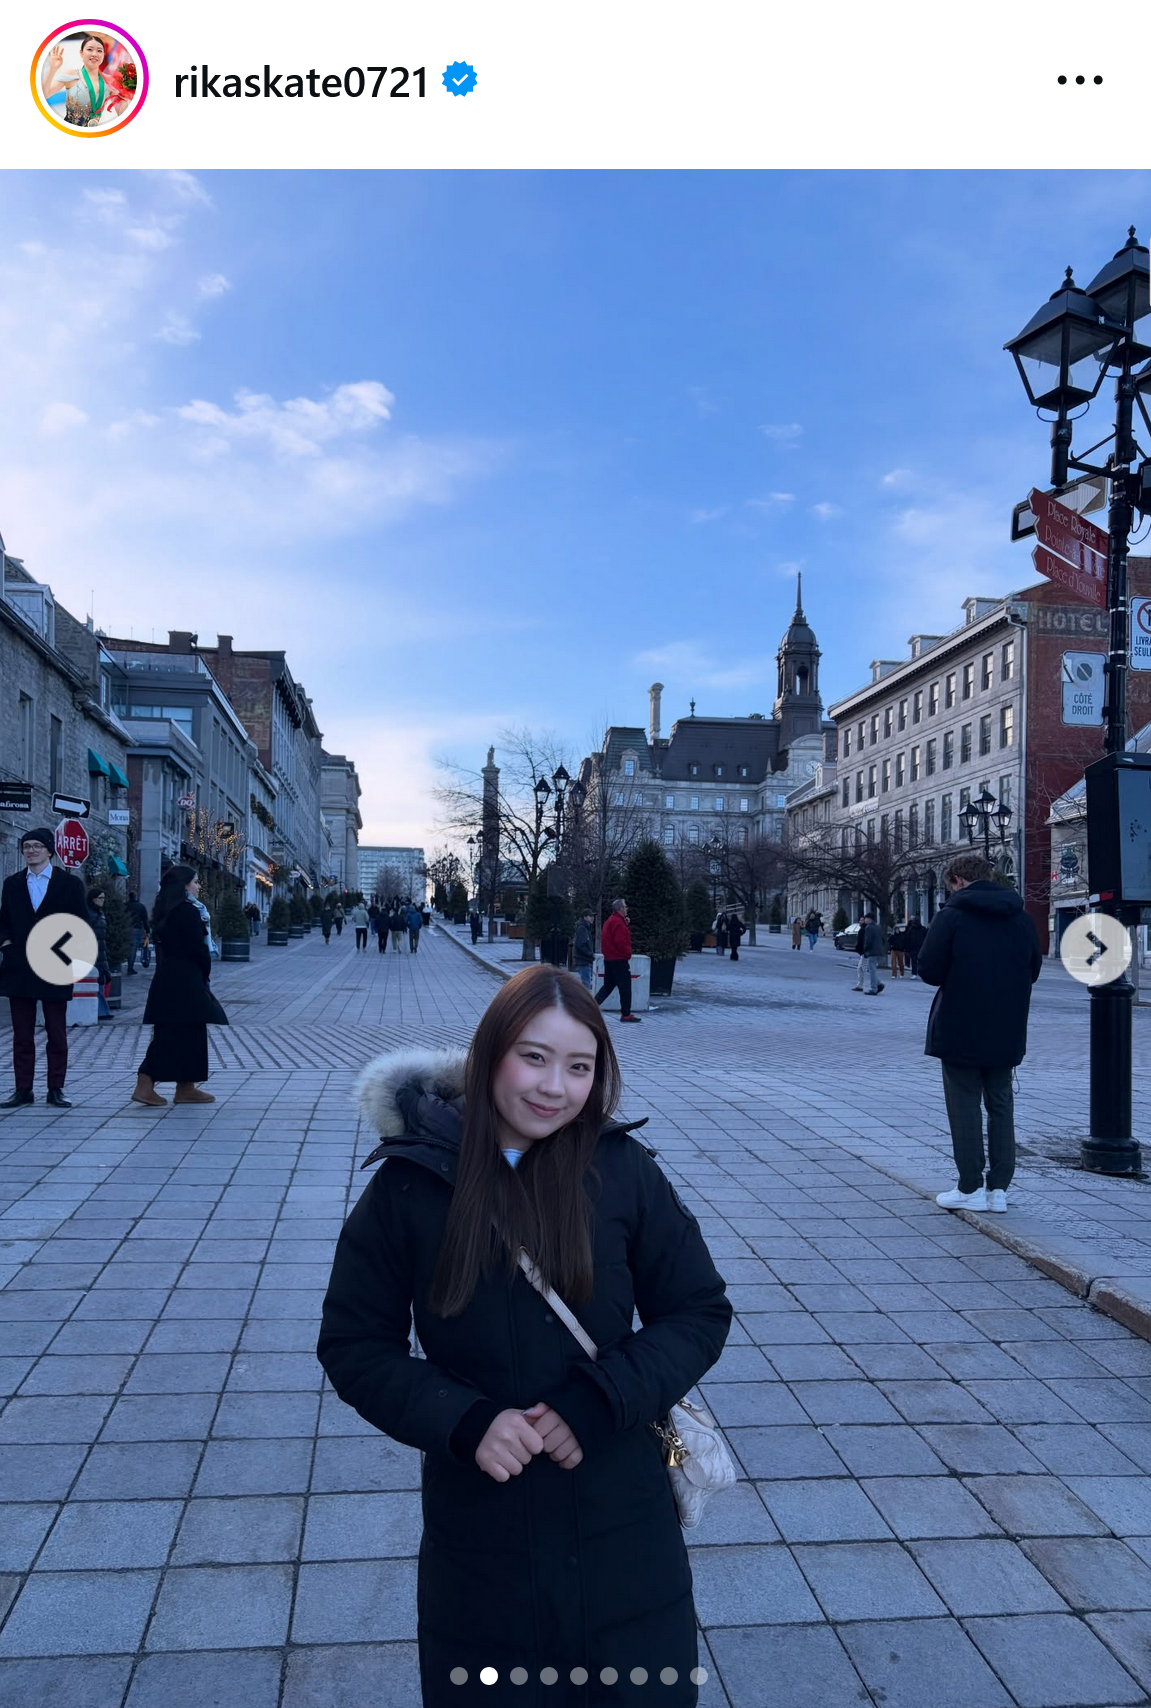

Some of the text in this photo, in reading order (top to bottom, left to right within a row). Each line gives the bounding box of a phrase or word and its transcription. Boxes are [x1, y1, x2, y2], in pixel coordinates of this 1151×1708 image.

[1047, 501, 1096, 543] Place Royale
[1046, 556, 1068, 583] Place
[1039, 610, 1108, 632] HOTEL
[1074, 693, 1093, 704] CÔTÉ
[1072, 705, 1094, 716] DROIT
[180, 799, 194, 807] DQ
[57, 835, 87, 852] ARRÊT
